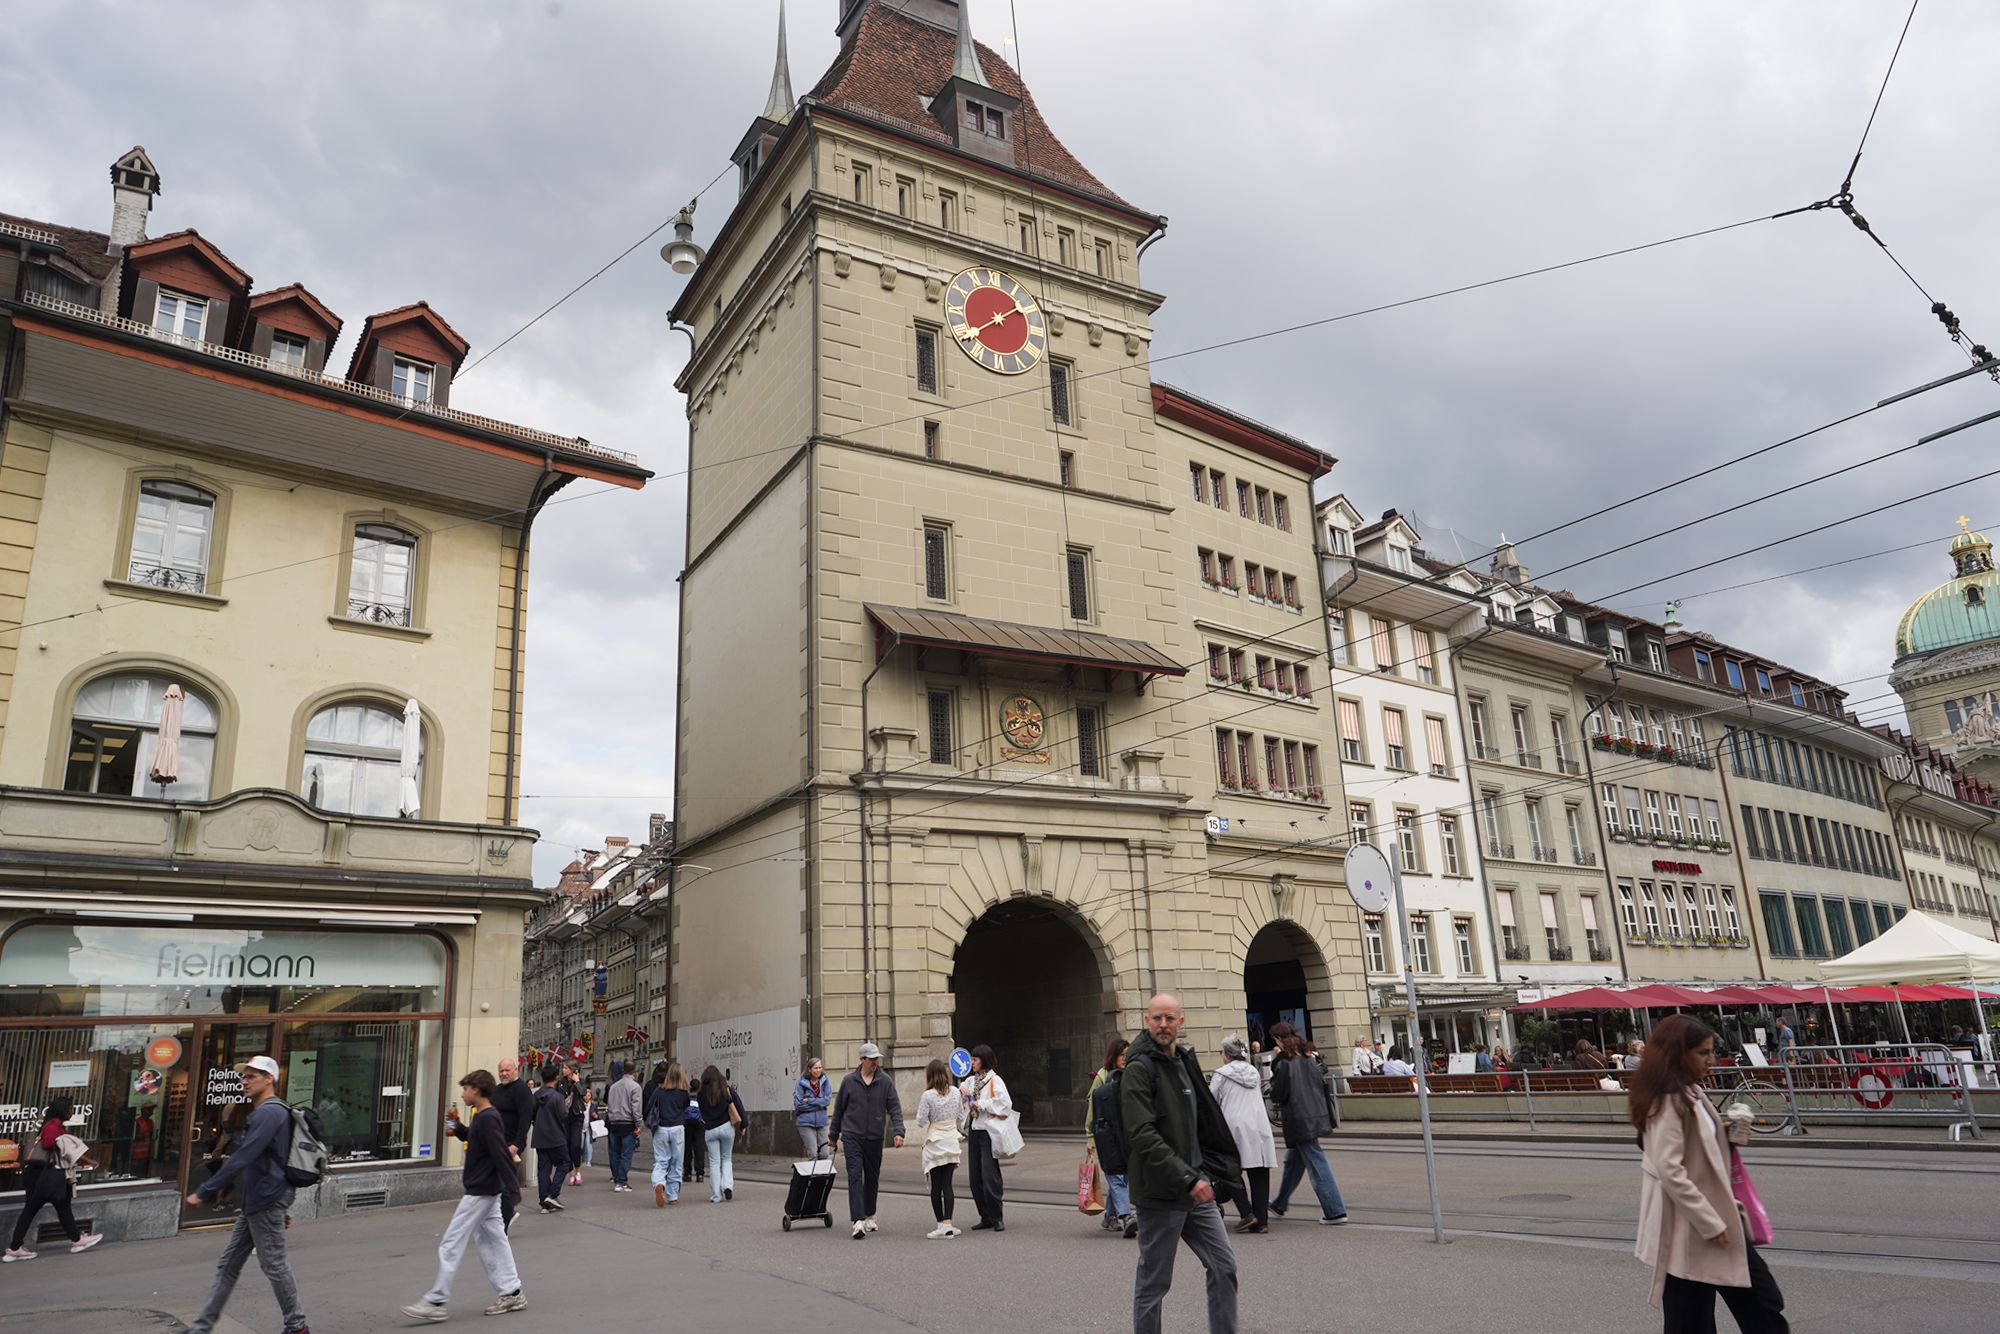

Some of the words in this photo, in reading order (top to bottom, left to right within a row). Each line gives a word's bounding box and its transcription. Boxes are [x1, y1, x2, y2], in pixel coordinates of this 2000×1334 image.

[987, 270, 1001, 287] XII
[1029, 324, 1044, 338] III
[1209, 820, 1219, 830] 15
[156, 942, 315, 978] fielmann
[710, 1029, 753, 1050] CasaBlanca
[207, 1080, 244, 1093] fielma
